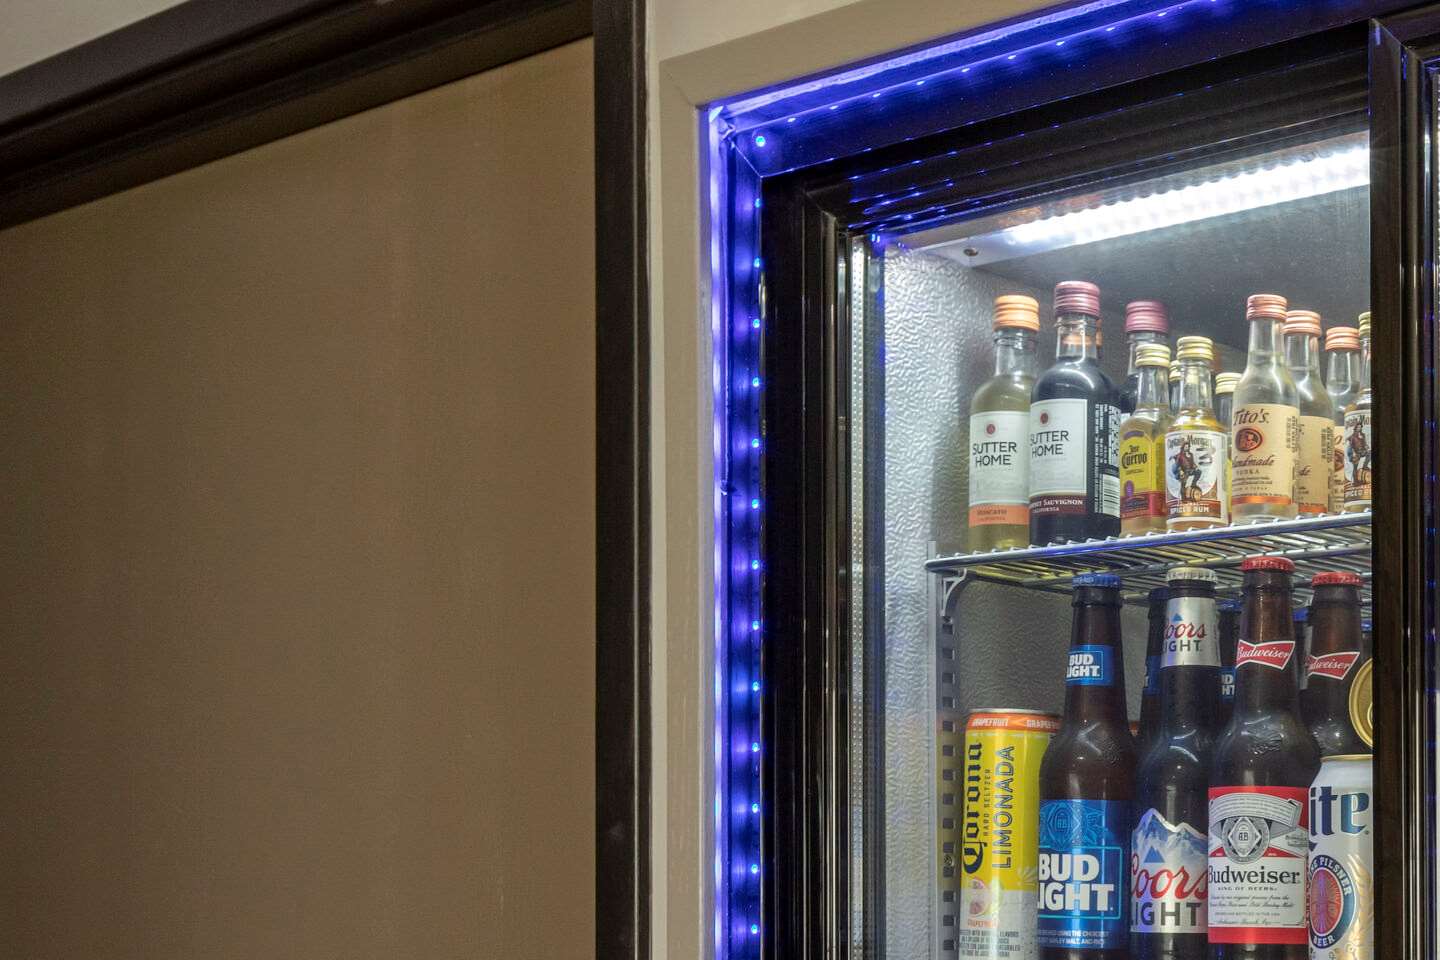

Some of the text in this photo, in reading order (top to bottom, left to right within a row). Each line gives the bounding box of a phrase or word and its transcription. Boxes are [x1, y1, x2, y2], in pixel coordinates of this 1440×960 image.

[1232, 408, 1269, 427] Tito's
[972, 441, 1017, 455] SUTTER
[1031, 443, 1064, 458] HOME
[975, 454, 1012, 467] HOME
[1121, 452, 1147, 469] Cuervo
[1043, 499, 1083, 507] SAUVIGNON
[1164, 622, 1207, 640] oors
[1165, 640, 1201, 652] IGHT
[1238, 645, 1291, 660] Budweiser
[1069, 653, 1094, 665] BUD
[963, 742, 983, 875] Corona
[992, 745, 1015, 869] LIMONADA
[1310, 786, 1370, 836] ite
[1039, 854, 1100, 881] BUD
[1208, 865, 1301, 884] Budweiser
[1320, 856, 1353, 896] PILSNER
[1038, 884, 1111, 911] IGHT
[1133, 902, 1203, 927] IGHT
[1313, 935, 1335, 947] BEER
